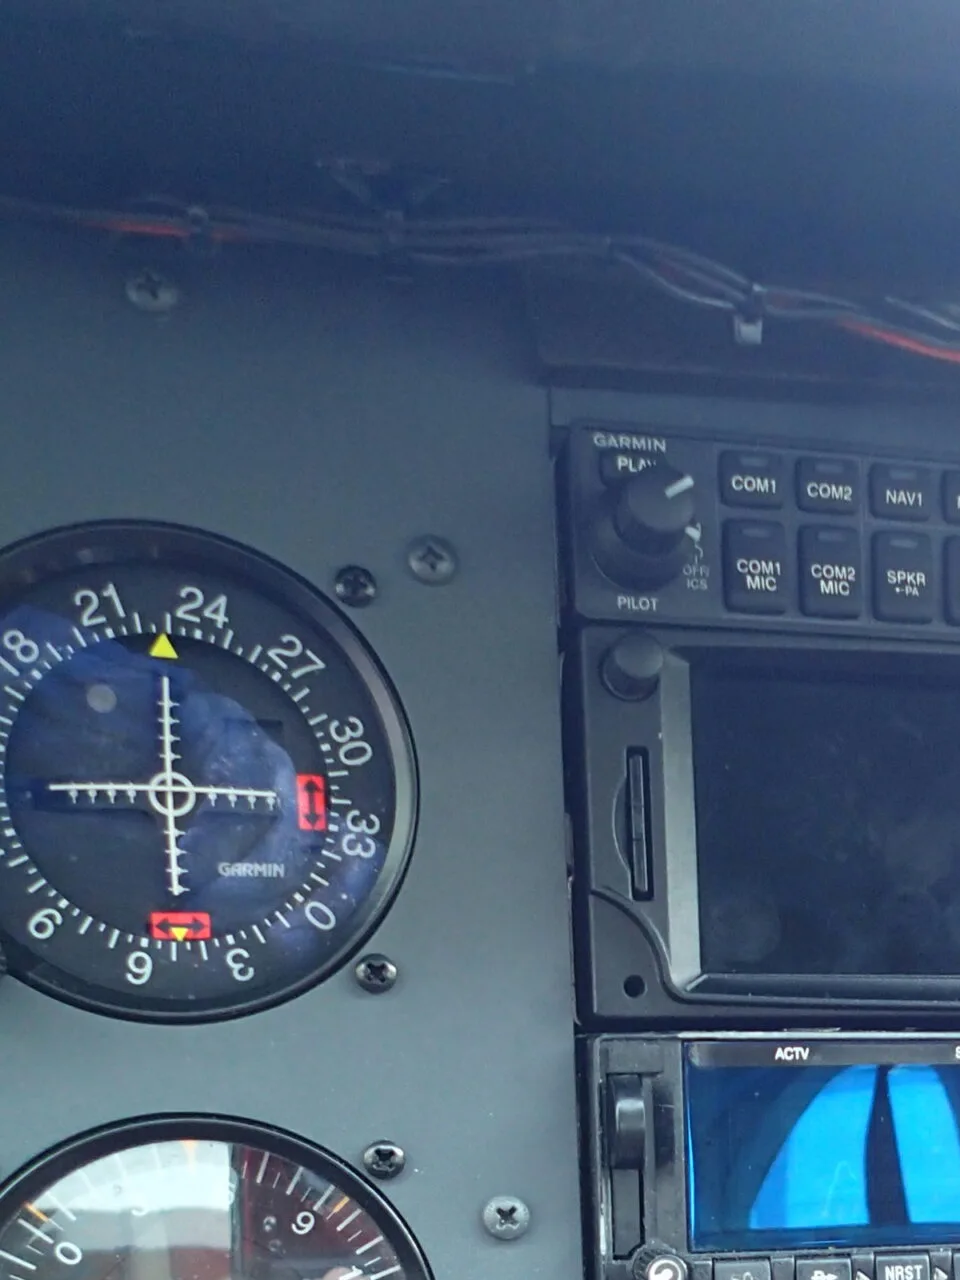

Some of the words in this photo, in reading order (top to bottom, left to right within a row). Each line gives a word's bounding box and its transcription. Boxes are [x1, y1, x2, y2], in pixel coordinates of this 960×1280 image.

[593, 432, 666, 453] GARMIN
[732, 475, 776, 494] COM1
[807, 483, 852, 501] COM2
[886, 489, 923, 507] NAV1
[737, 558, 781, 576] COM1
[811, 564, 856, 582] COM2
[686, 579, 708, 590] ICS
[746, 575, 777, 592] MIC
[887, 570, 926, 586] SPKR
[820, 579, 850, 596] MIC
[905, 585, 919, 597] PA
[74, 583, 125, 627] 21
[175, 585, 229, 628] 24
[617, 596, 659, 612] PILOT
[267, 633, 326, 679] 27
[330, 716, 373, 766] 30
[342, 810, 380, 859] 33
[218, 862, 284, 877] GARMIN
[775, 1047, 809, 1060] ACTV
